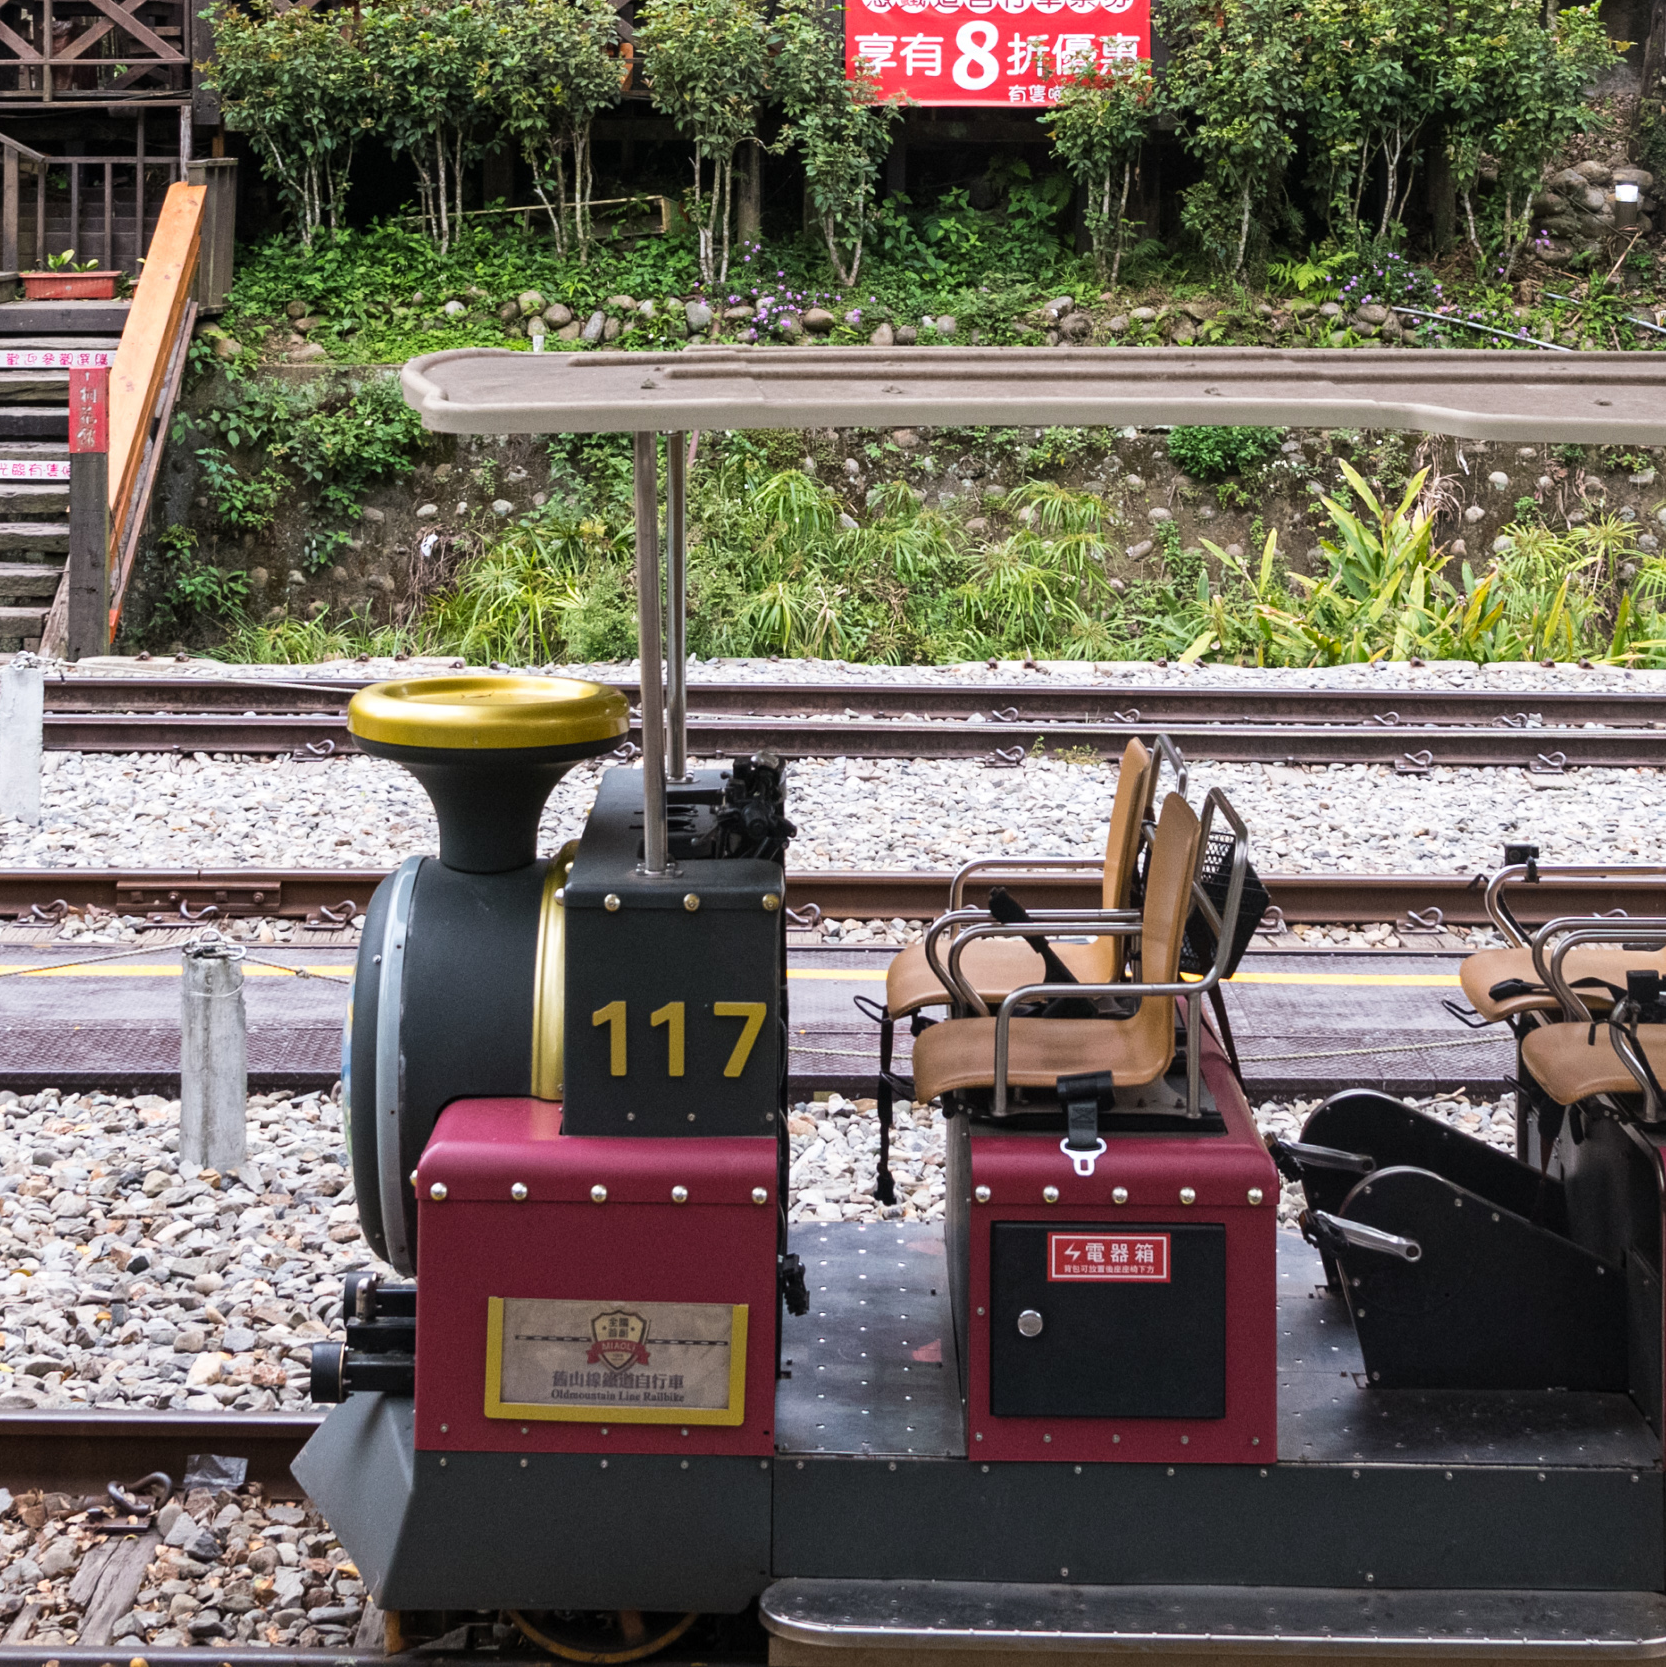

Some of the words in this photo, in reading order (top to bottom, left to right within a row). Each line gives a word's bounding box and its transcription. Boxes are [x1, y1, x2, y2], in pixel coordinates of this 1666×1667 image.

[591, 1000, 767, 1078] 117
[1085, 1242, 1154, 1263] 電器箱
[601, 1341, 636, 1352] MIAOLI
[551, 1389, 615, 1401] Oldmountain
[618, 1391, 641, 1401] Line
[643, 1392, 685, 1403] Railbike
